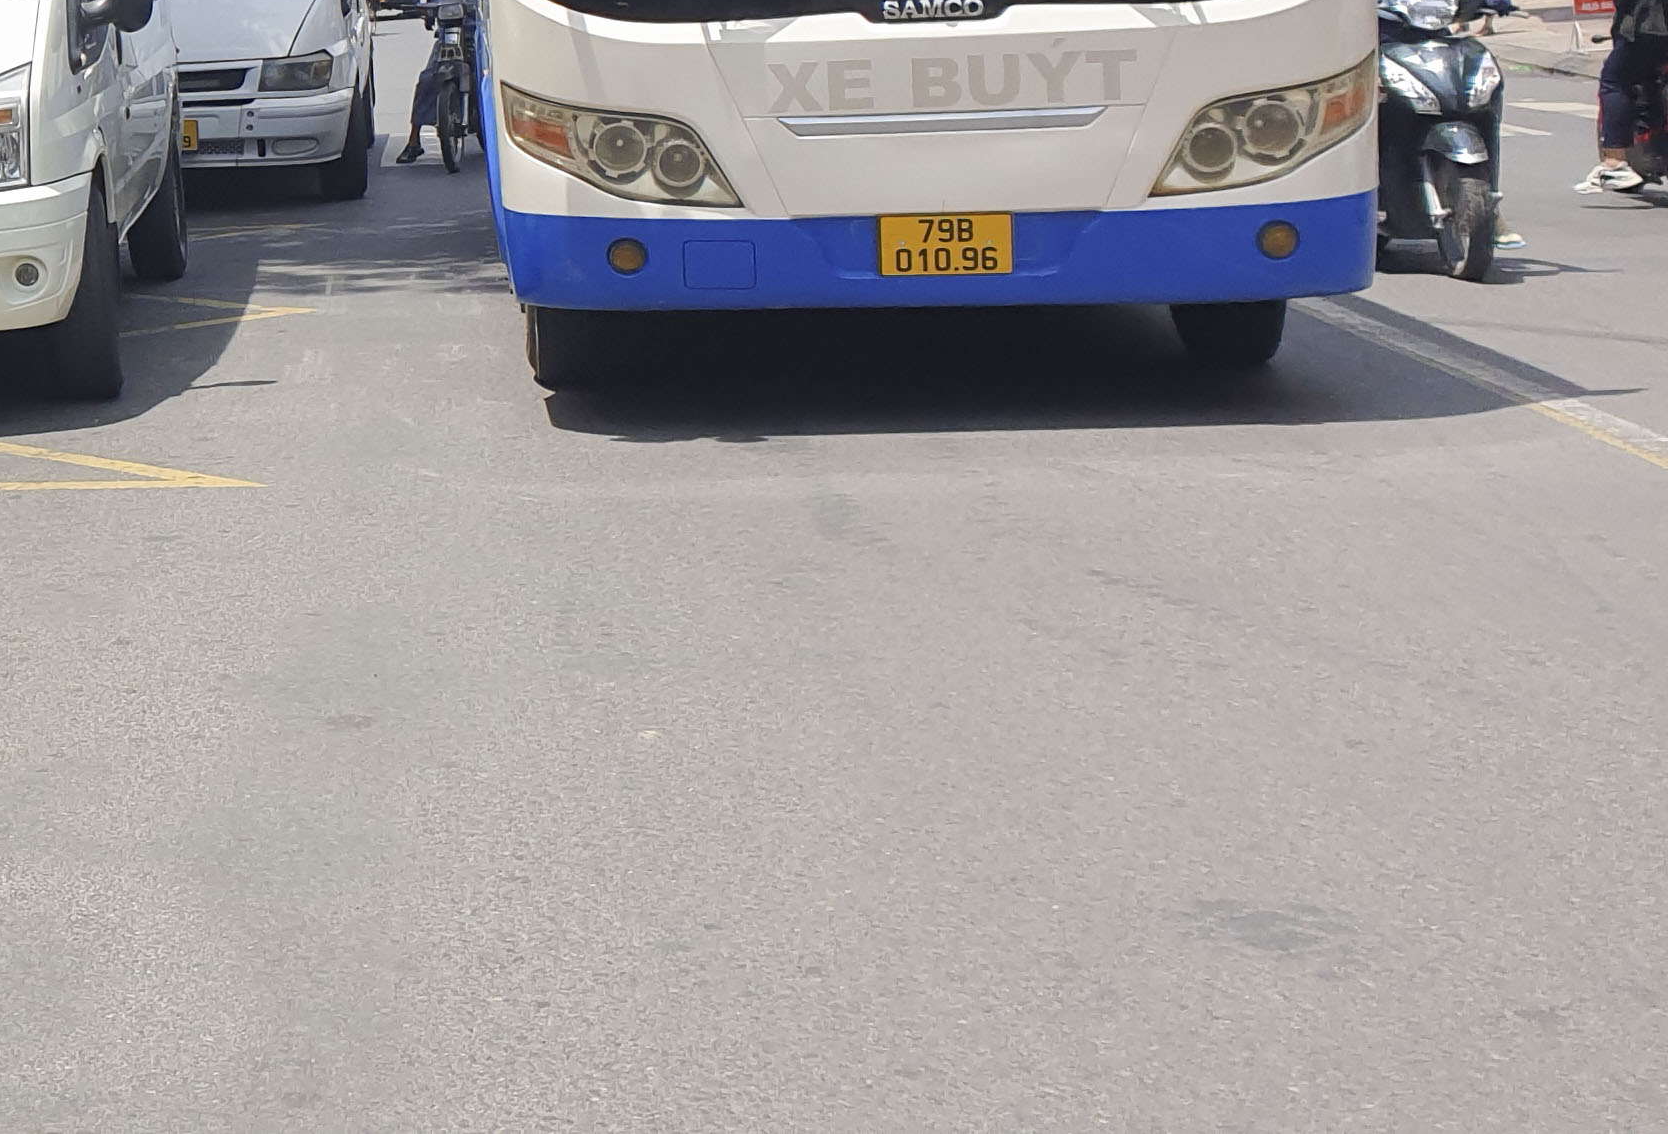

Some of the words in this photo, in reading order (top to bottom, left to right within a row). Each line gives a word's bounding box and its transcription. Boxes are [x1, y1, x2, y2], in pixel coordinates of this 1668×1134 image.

[767, 59, 875, 114] XE
[911, 38, 1138, 110] BUÝT
[918, 218, 974, 244] 79B
[895, 247, 998, 274] 010.96
